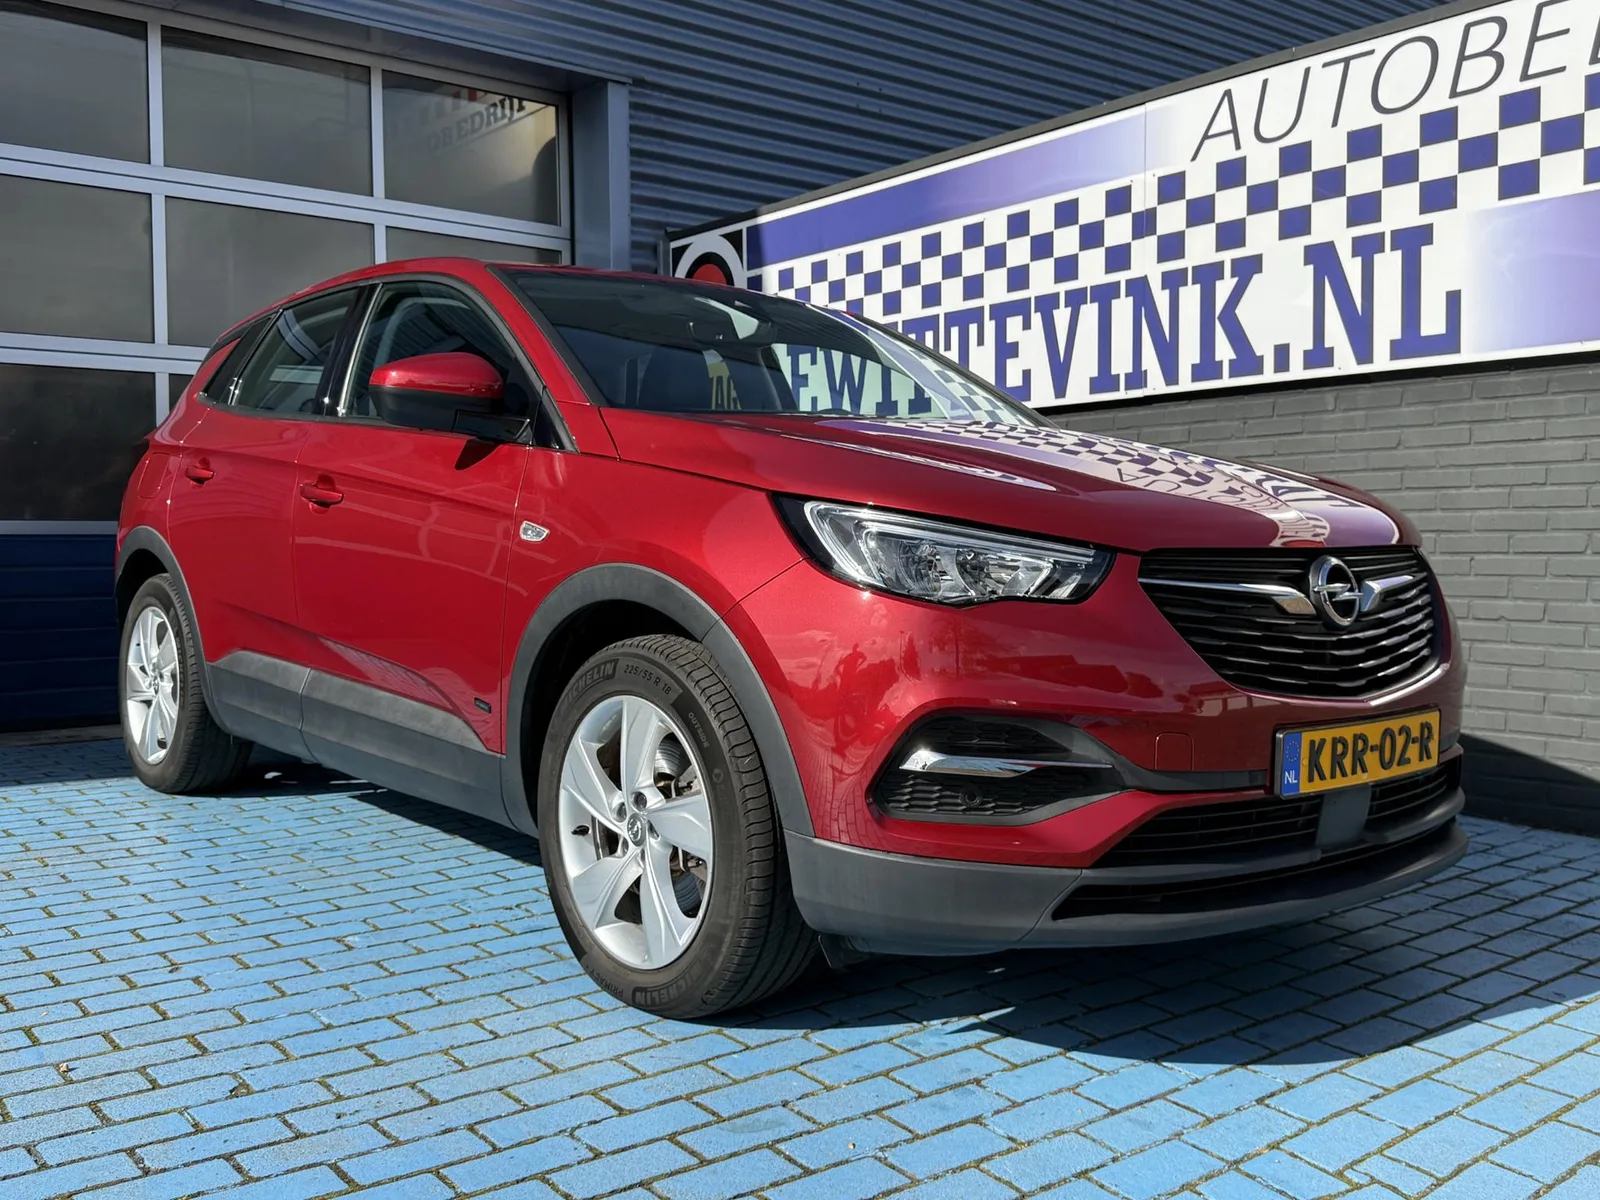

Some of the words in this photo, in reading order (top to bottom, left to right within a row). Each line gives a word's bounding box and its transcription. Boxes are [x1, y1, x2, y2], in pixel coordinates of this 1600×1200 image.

[624, 664, 653, 680] 225/55
[653, 676, 661, 687] R
[661, 683, 672, 695] 18
[1308, 721, 1434, 783] KRR-02-R
[1284, 770, 1298, 784] NL
